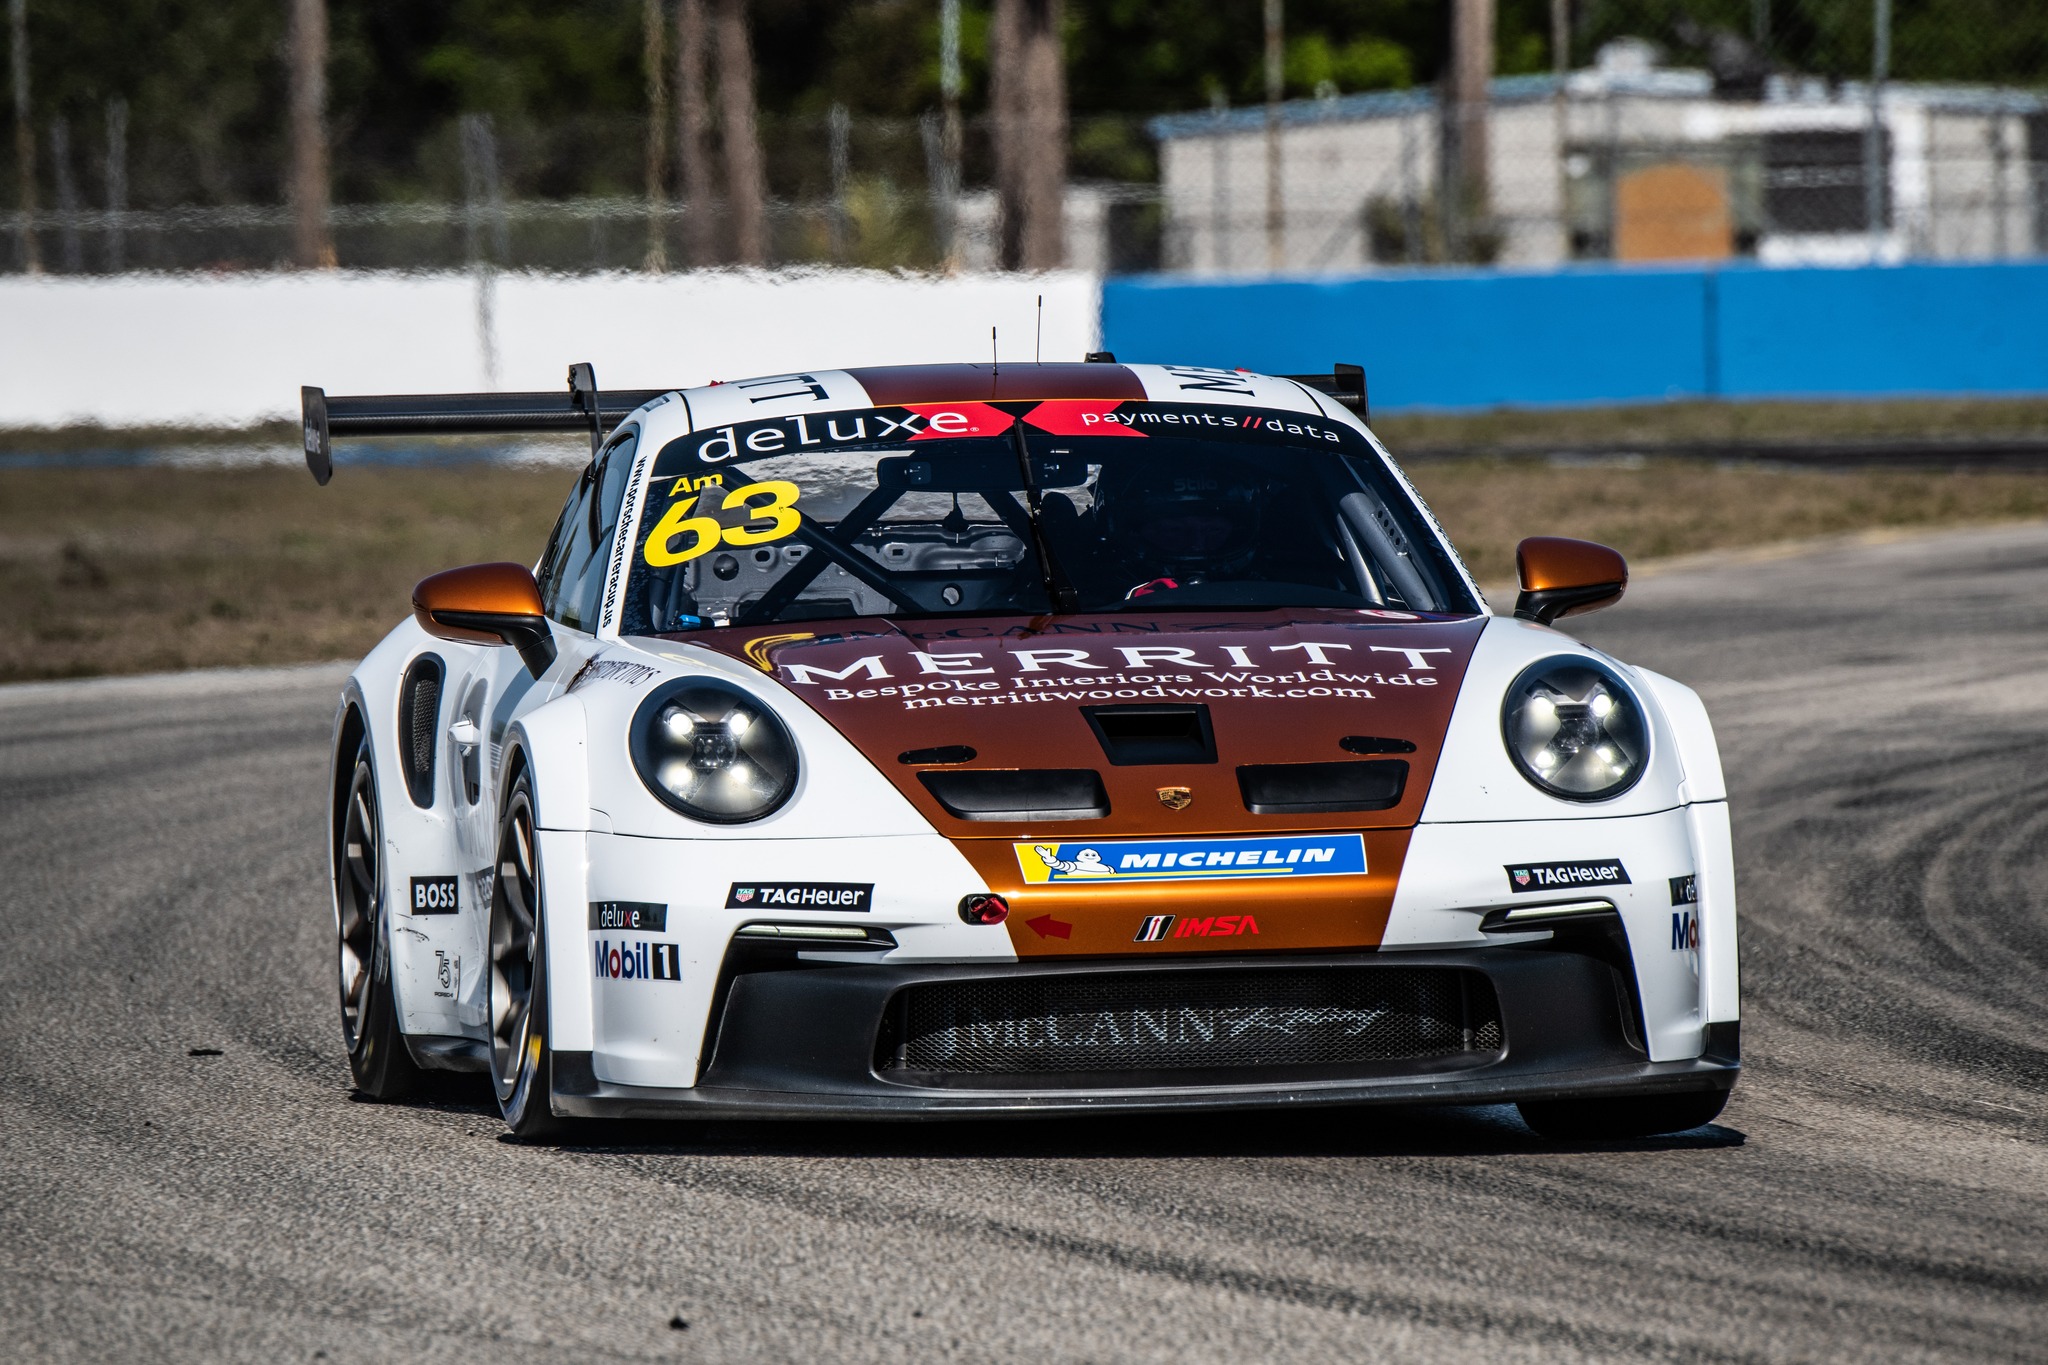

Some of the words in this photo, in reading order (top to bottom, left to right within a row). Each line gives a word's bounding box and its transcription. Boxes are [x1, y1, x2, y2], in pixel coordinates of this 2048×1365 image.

[668, 473, 723, 497] Am
[643, 480, 802, 568] 63
[602, 455, 648, 629] www.porschecarreracup.us
[779, 641, 1452, 685] MERRITT
[824, 679, 1000, 700] Bespoke
[1010, 672, 1193, 688] Interiors
[1201, 669, 1438, 686] Worldwide
[903, 684, 1376, 710] merrittwoodwork.com
[1119, 848, 1336, 869] MICHELIN
[415, 883, 455, 908] BOSS
[601, 903, 640, 928] deluxe
[1174, 915, 1260, 939] IMSA
[595, 940, 649, 979] Mobil
[659, 945, 672, 979] 1
